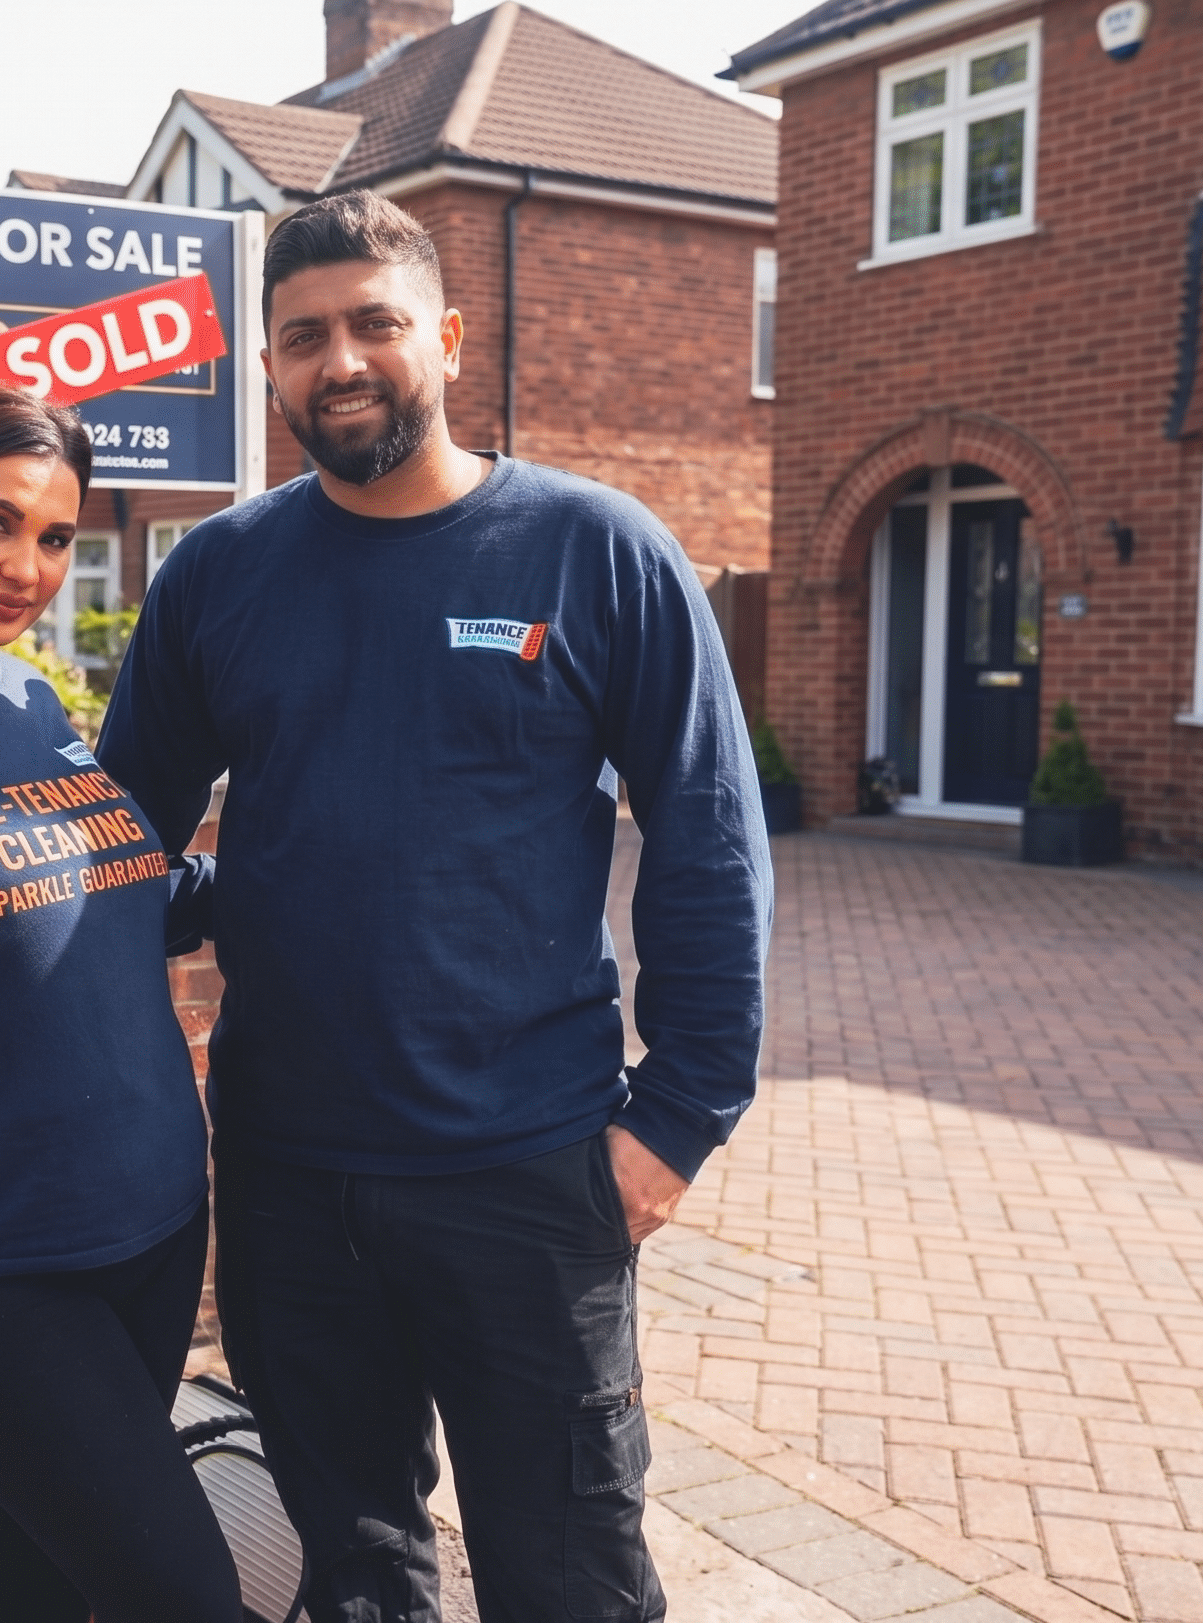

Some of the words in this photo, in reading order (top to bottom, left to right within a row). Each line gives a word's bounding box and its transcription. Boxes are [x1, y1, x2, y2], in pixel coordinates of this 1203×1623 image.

[86, 226, 203, 277] SALE
[5, 299, 192, 401] SOLD
[455, 622, 528, 640] TENANCE
